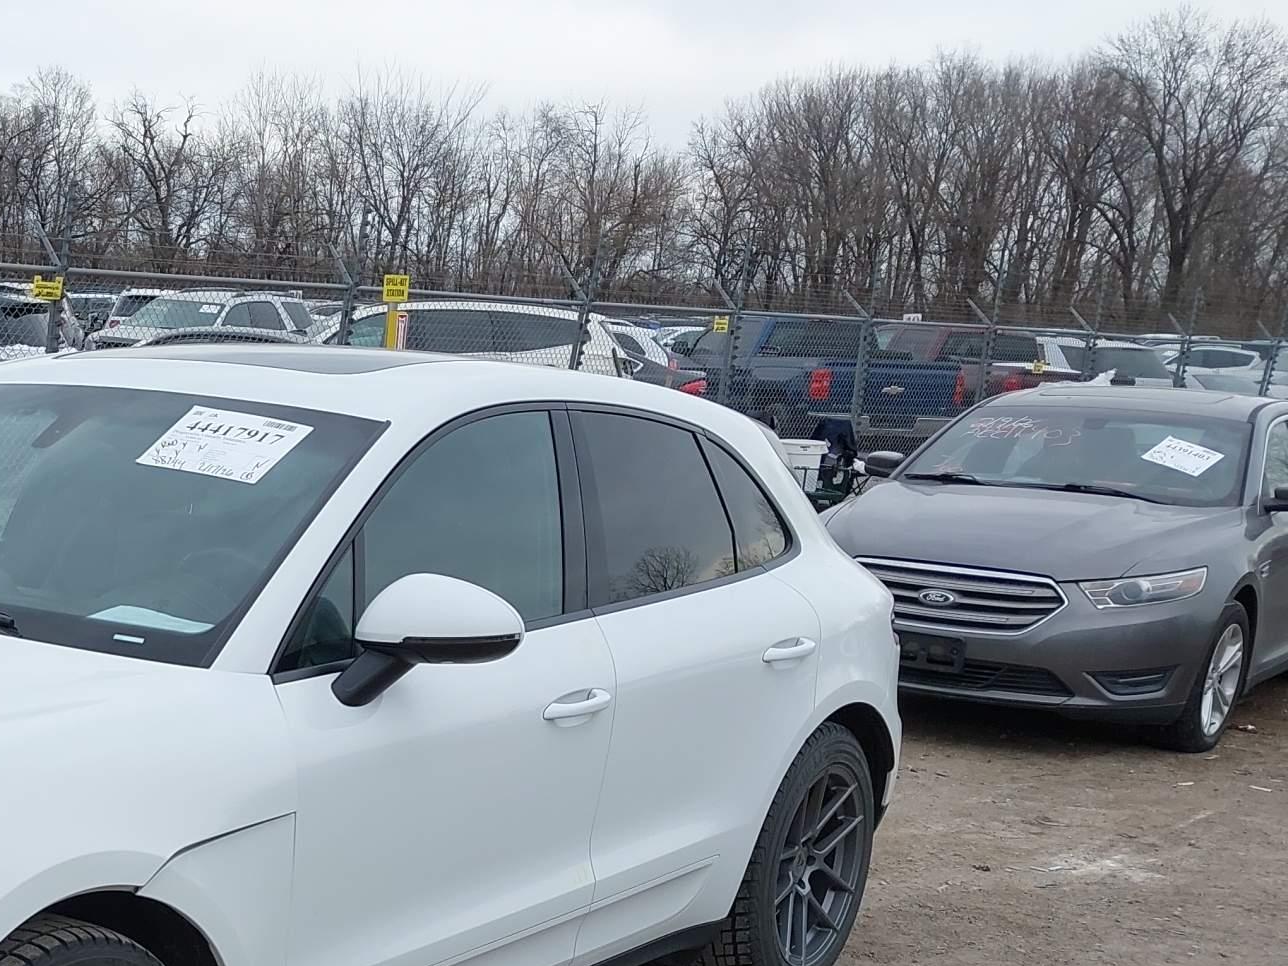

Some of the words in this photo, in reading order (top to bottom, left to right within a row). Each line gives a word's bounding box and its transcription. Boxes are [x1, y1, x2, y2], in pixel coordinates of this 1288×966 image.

[386, 277, 407, 287] SPILL-KIT
[386, 289, 405, 297] STATION
[185, 420, 286, 445] 44417917
